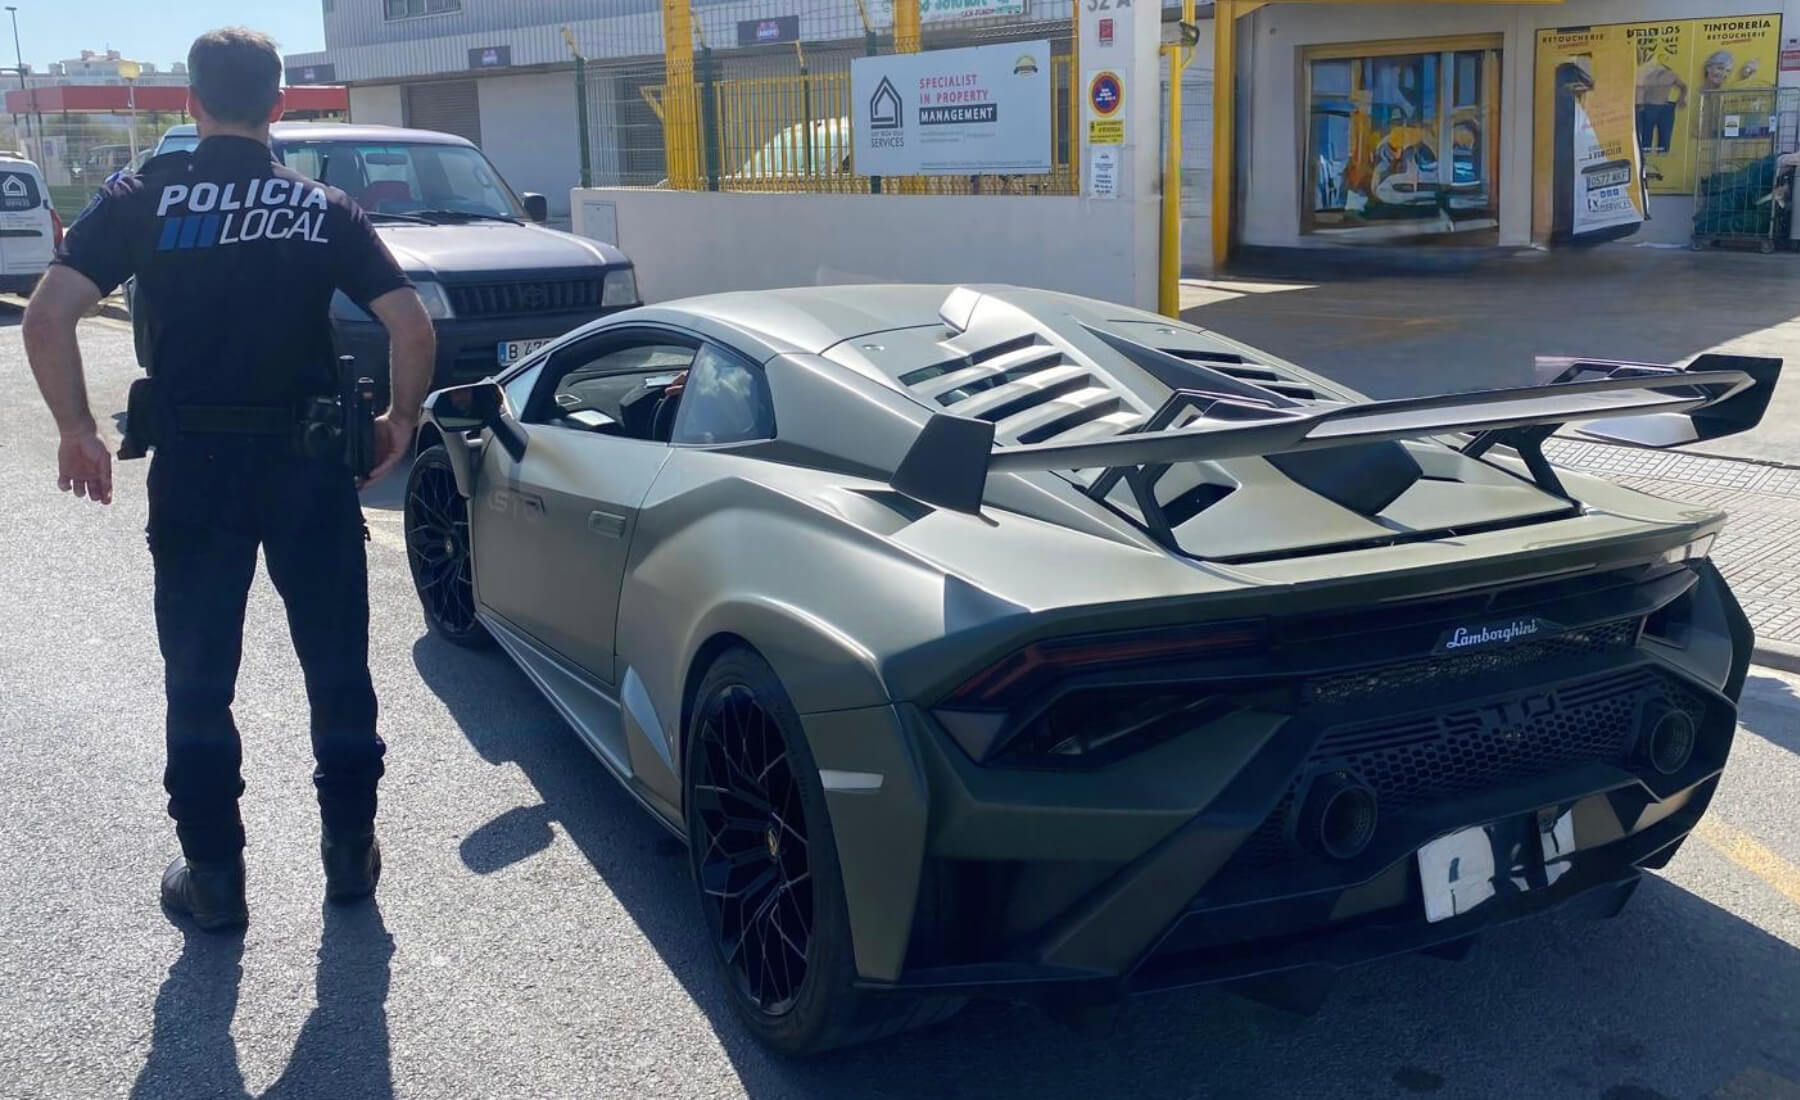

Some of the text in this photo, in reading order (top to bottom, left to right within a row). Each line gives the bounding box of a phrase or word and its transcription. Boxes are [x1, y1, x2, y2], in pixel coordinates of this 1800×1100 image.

[1703, 20, 1771, 32] TINTORERÍA
[919, 74, 978, 89] SPECIALIST
[919, 89, 988, 104] IN PROPERTY
[921, 107, 993, 123] MANAGEMENT
[871, 137, 904, 148] SERVICES
[157, 178, 328, 217] POLICIA
[219, 208, 329, 244] LOCAL
[509, 344, 518, 359] B
[1446, 619, 1538, 648] Lamborghini
